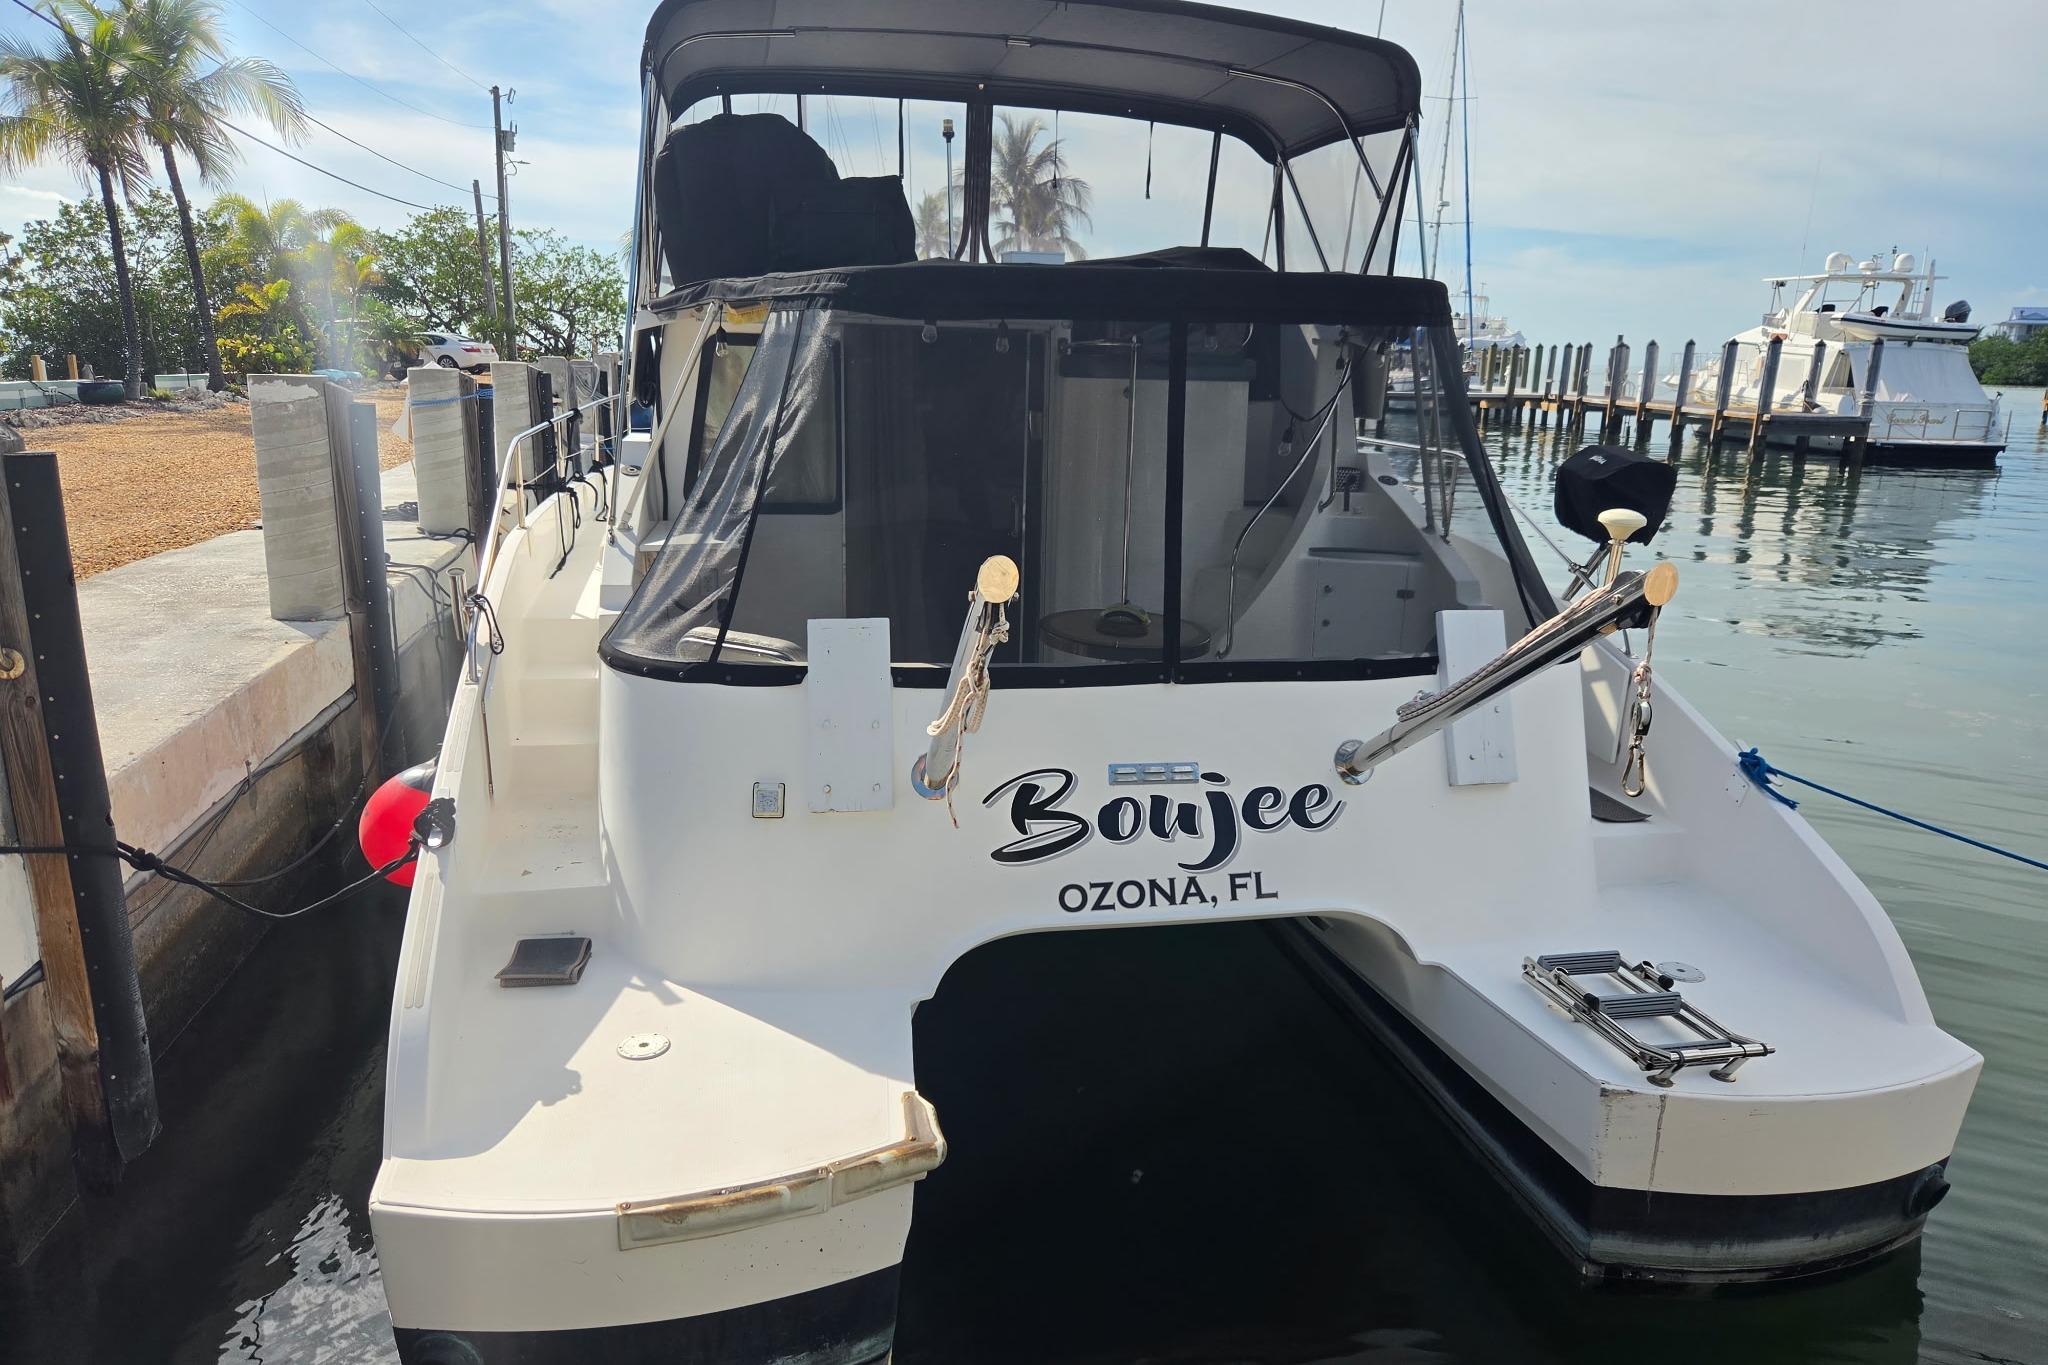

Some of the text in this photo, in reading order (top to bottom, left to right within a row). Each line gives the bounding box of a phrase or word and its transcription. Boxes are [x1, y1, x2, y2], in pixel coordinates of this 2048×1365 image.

[981, 768, 1345, 872] Boujee
[1058, 871, 1279, 912] OZONA, FL
